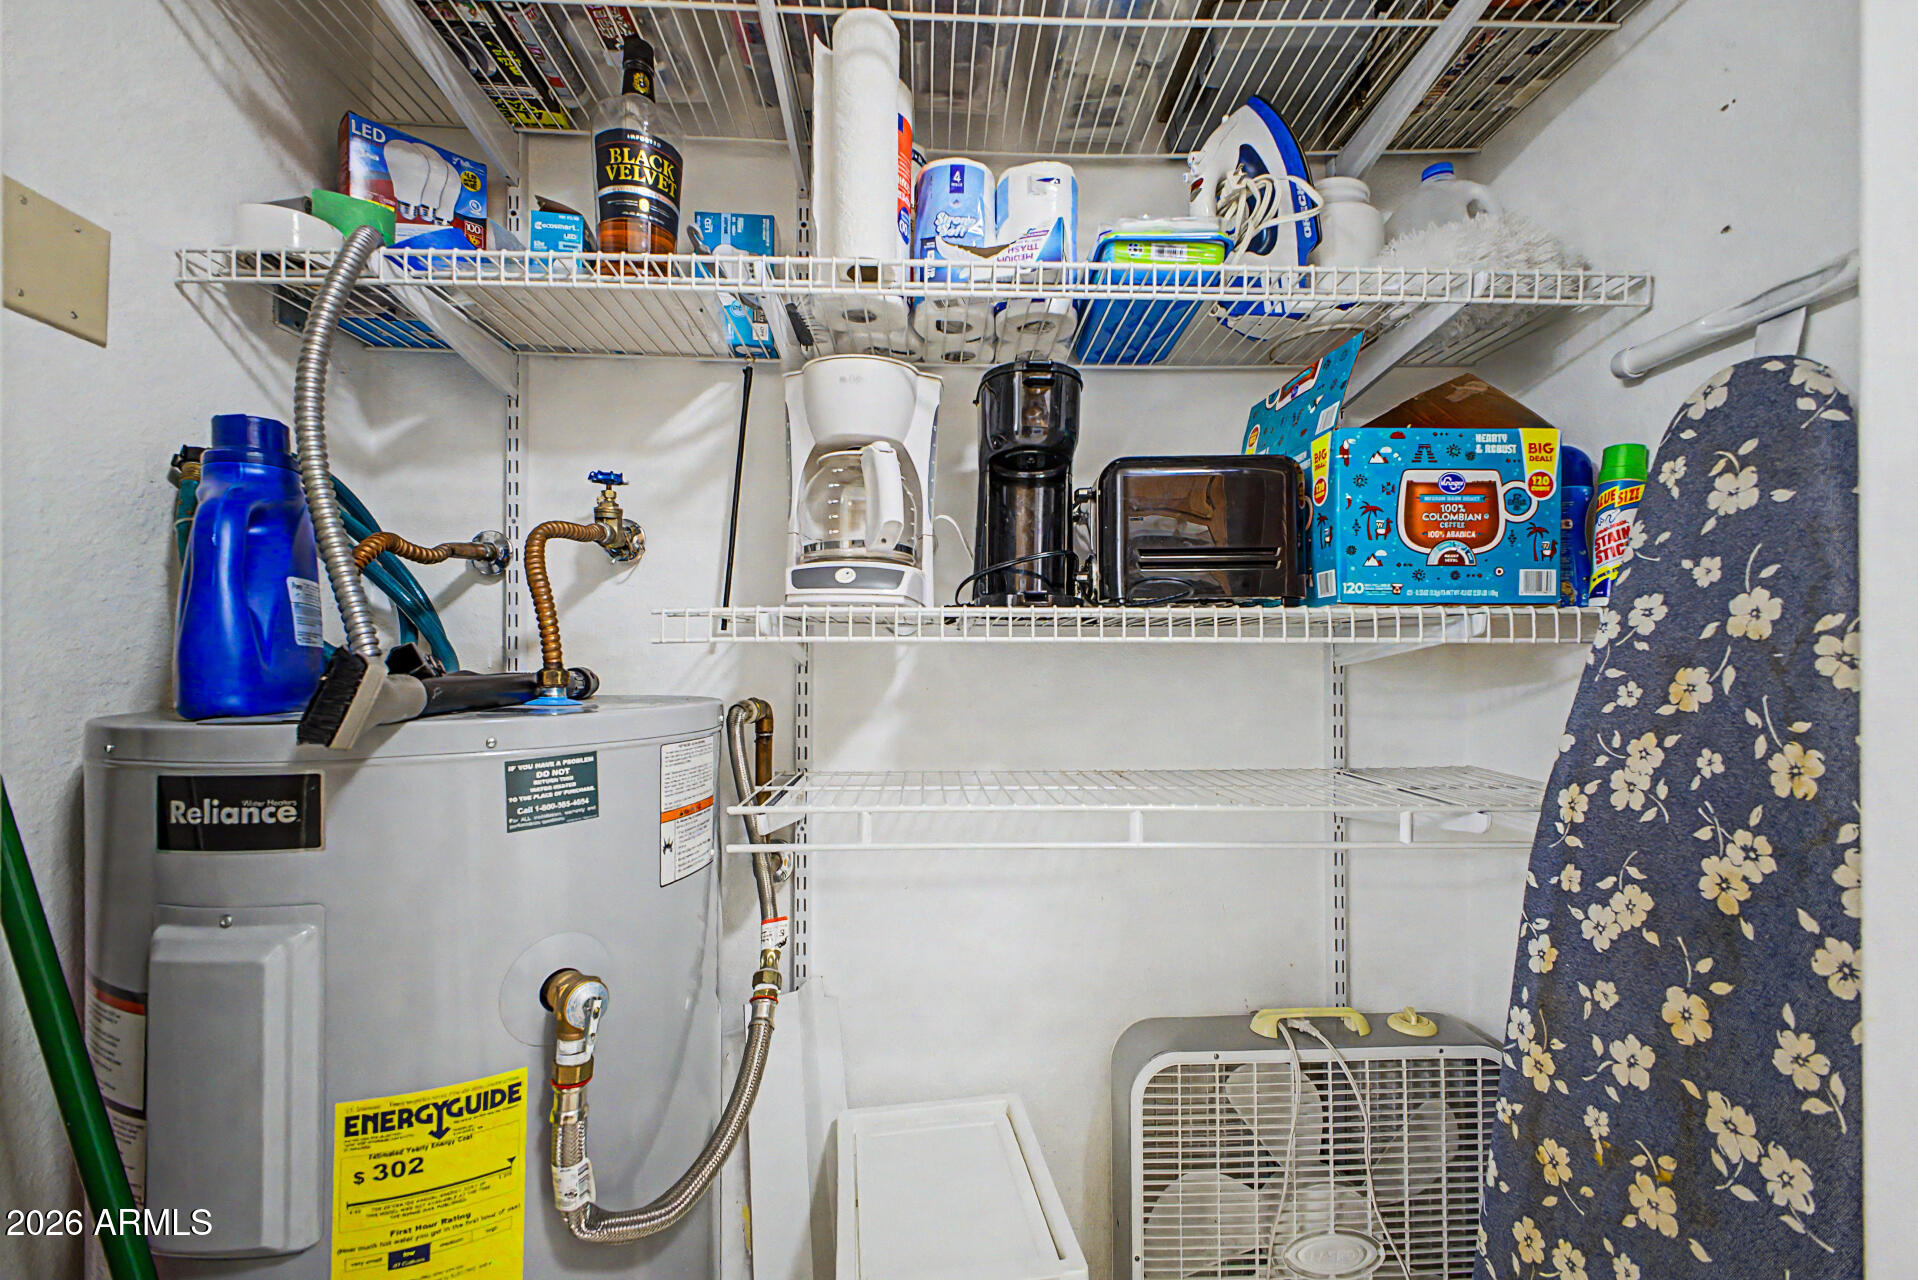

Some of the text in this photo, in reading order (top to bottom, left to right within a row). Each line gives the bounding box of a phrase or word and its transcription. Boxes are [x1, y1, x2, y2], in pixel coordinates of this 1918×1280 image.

[351, 119, 386, 143] LED
[608, 147, 675, 182] BLACK
[605, 164, 677, 198] VELVET
[953, 170, 962, 184] 4
[1528, 442, 1554, 454] BIG
[1616, 486, 1640, 504] SIZE
[1422, 512, 1482, 520] COLOMBIAN
[1440, 504, 1466, 513] 100%
[1594, 526, 1630, 552] STAIN
[1596, 541, 1628, 565] STIC
[1342, 582, 1364, 594] 120
[536, 768, 570, 778] DO NOT
[170, 798, 298, 824] Reliance
[517, 806, 533, 814] Call
[344, 1081, 522, 1140] ENERGYGUIDE
[406, 1144, 429, 1155] Yearly
[353, 1156, 424, 1186] $ 302
[390, 1212, 472, 1238] First Hour Rating
